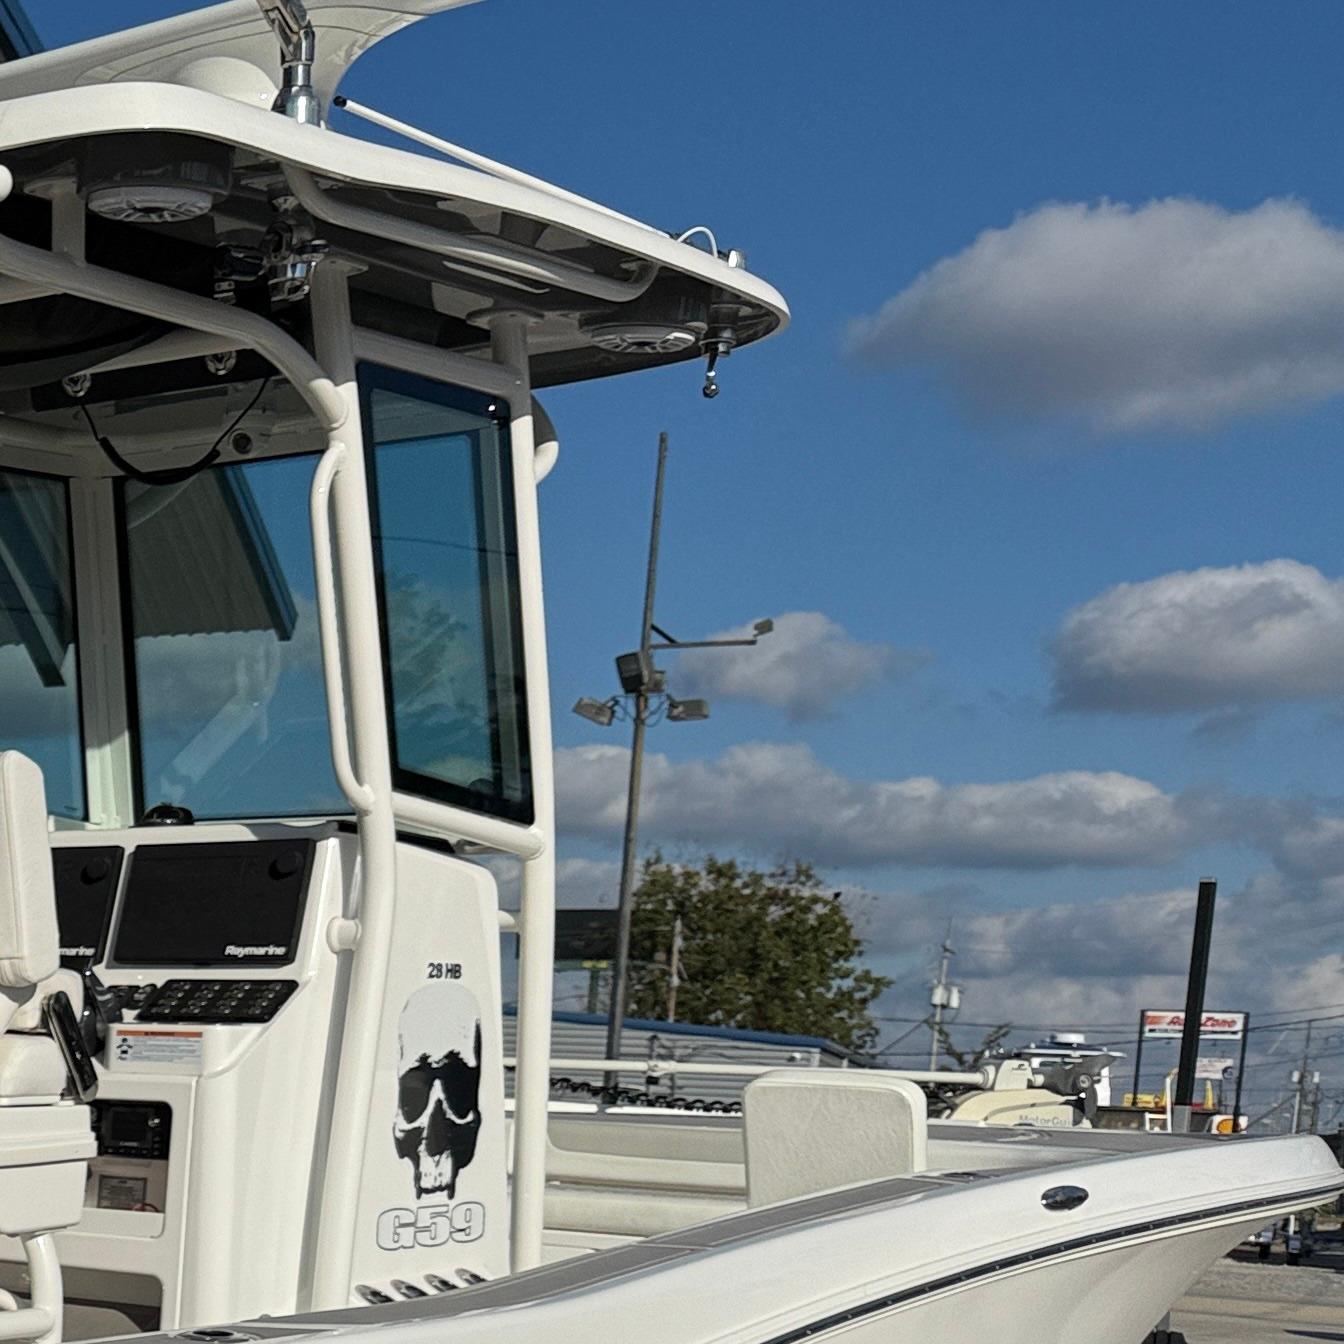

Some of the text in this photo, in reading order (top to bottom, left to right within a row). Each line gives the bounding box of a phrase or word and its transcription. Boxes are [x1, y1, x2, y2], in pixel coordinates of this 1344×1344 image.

[224, 944, 287, 958] Raymarine
[427, 962, 463, 979] 28 HB
[376, 1201, 486, 1251] G59
